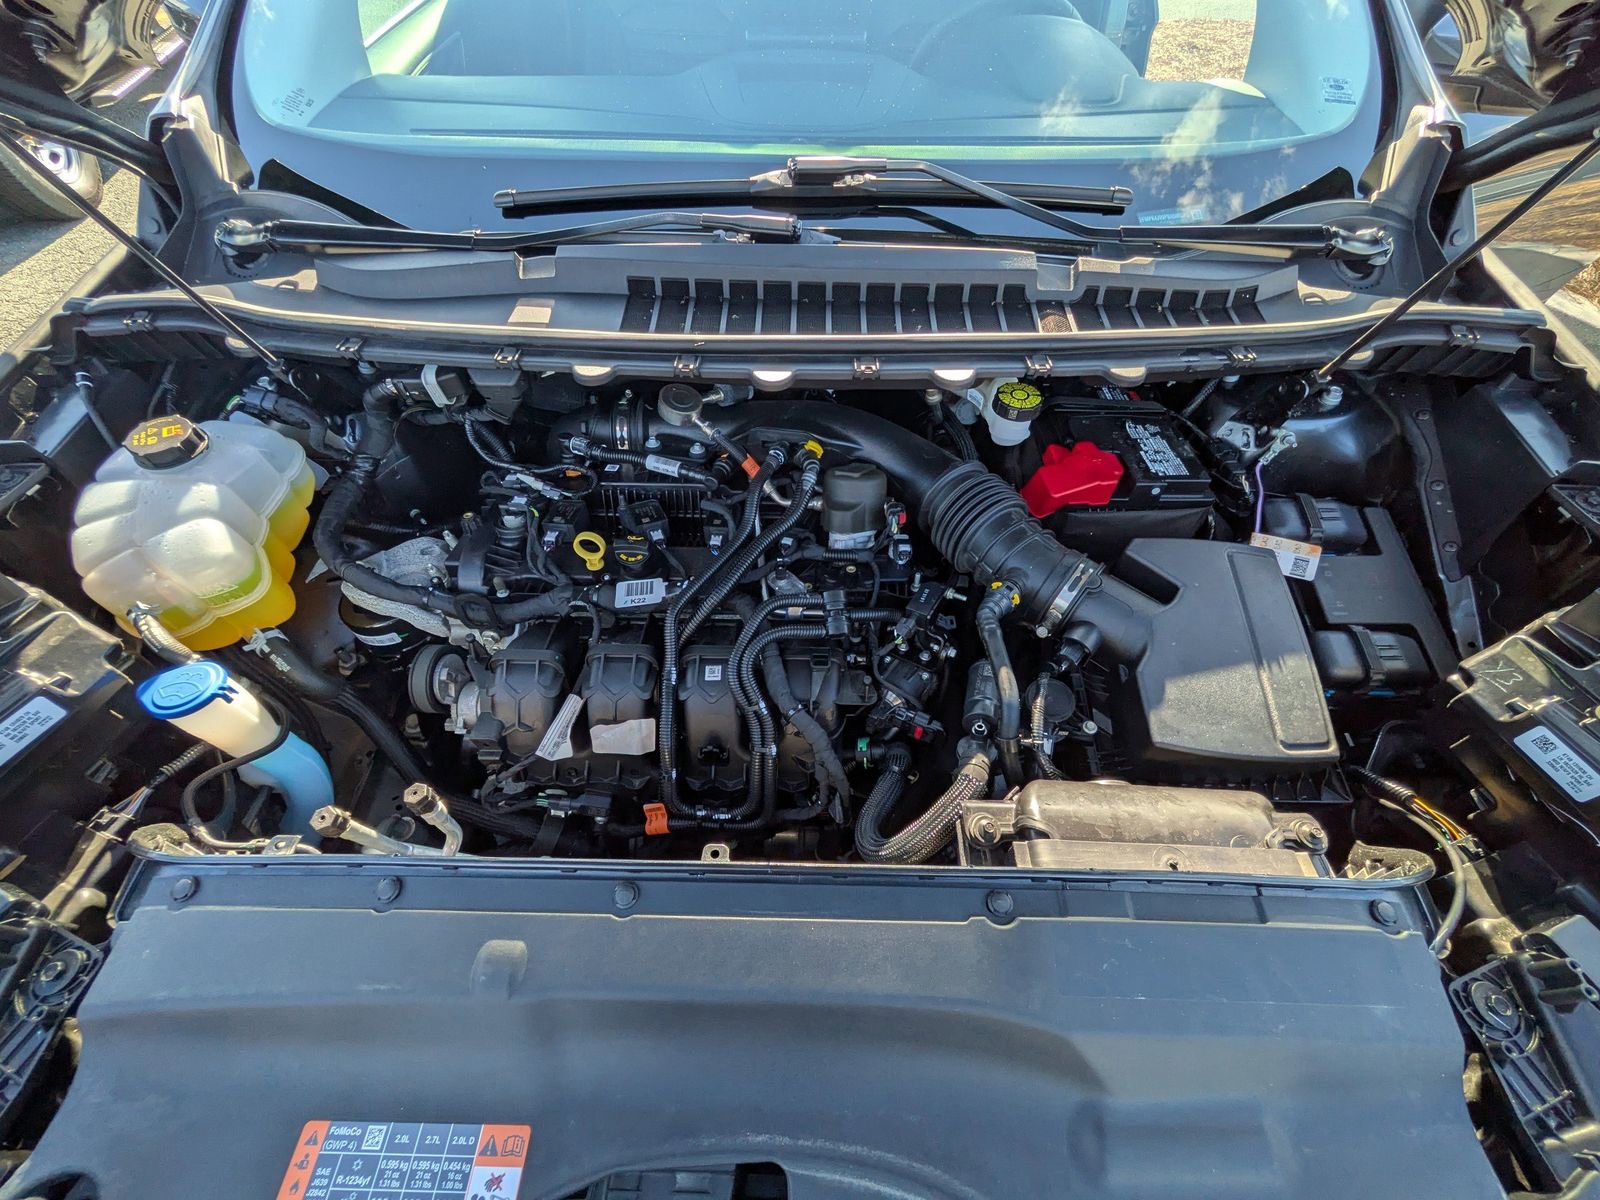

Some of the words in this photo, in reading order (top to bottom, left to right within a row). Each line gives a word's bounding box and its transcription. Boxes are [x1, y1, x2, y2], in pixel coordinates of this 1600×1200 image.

[329, 1126, 362, 1136] FoMoCo
[394, 1134, 410, 1143] 2.0L
[425, 1136, 440, 1144] 2.7L
[452, 1136, 466, 1144] 2.0L
[322, 1140, 347, 1151] (GWP
[348, 1141, 357, 1152] 4)
[400, 1160, 408, 1172] kg
[430, 1161, 440, 1172] kg
[462, 1162, 470, 1173] kg
[316, 1168, 332, 1176] SAE
